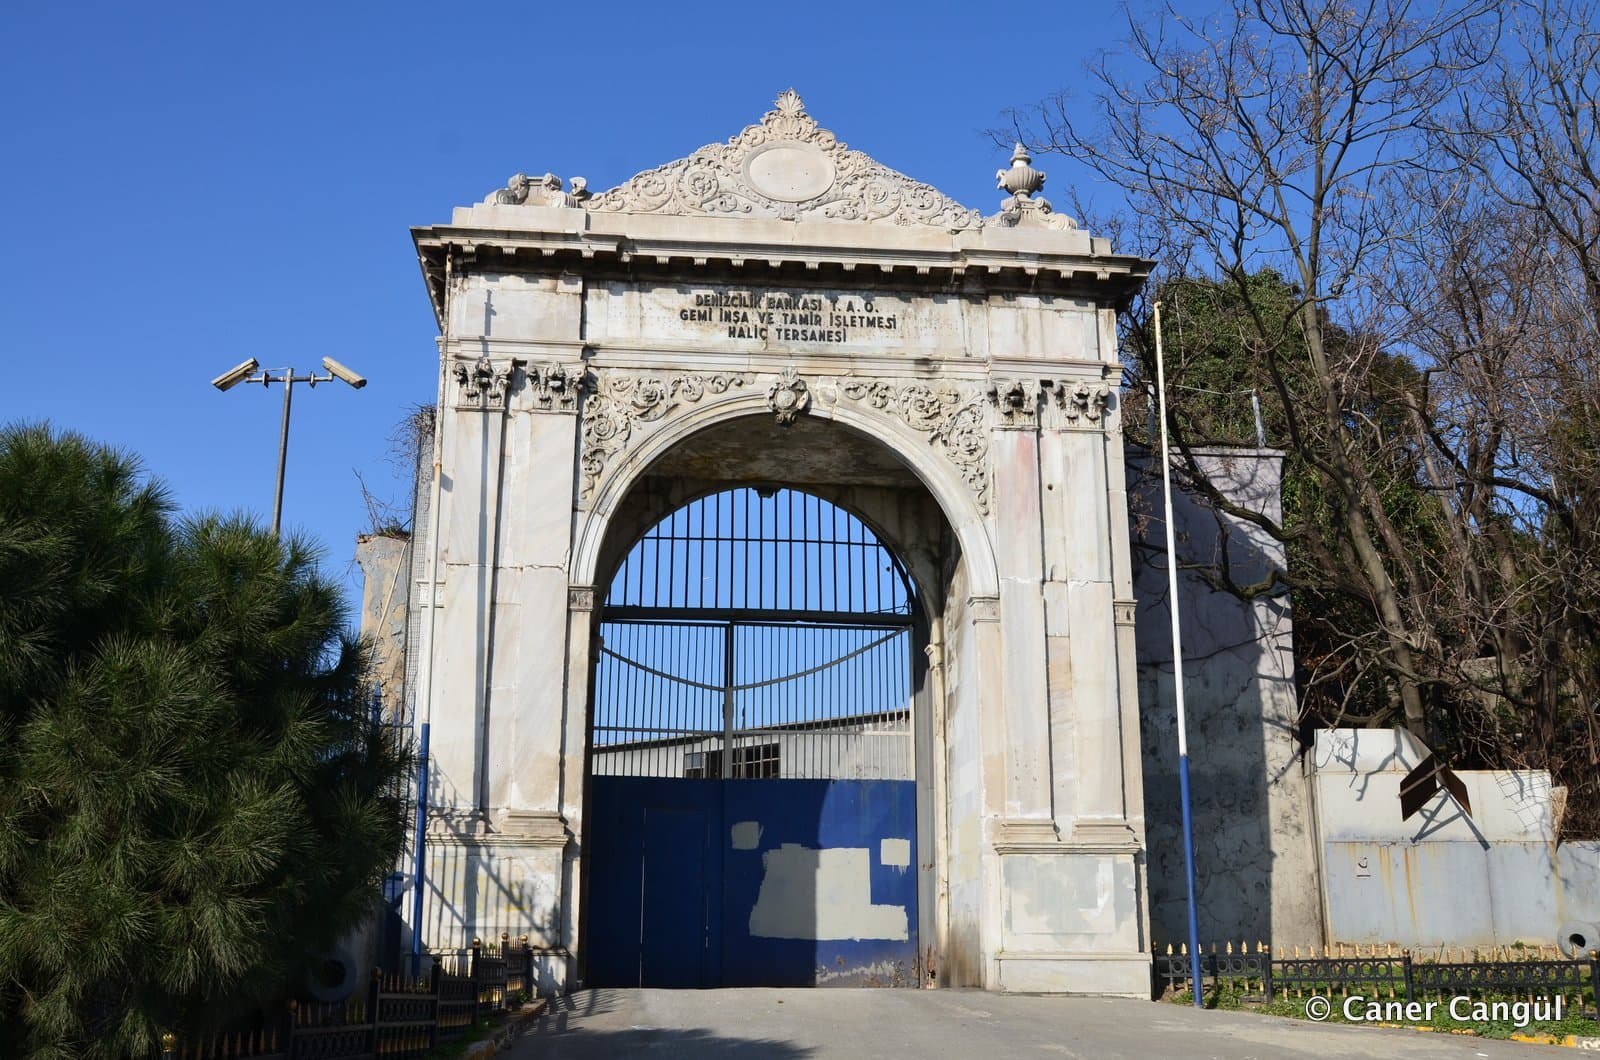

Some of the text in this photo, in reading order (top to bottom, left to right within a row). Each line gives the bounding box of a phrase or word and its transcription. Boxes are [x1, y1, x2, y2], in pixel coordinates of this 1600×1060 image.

[767, 296, 822, 312] BANKASI
[680, 307, 897, 330] GEMİ İNŞA VE TAMİR İŞLETMESİ
[728, 325, 847, 343] HALİÇ TERSANESİ
